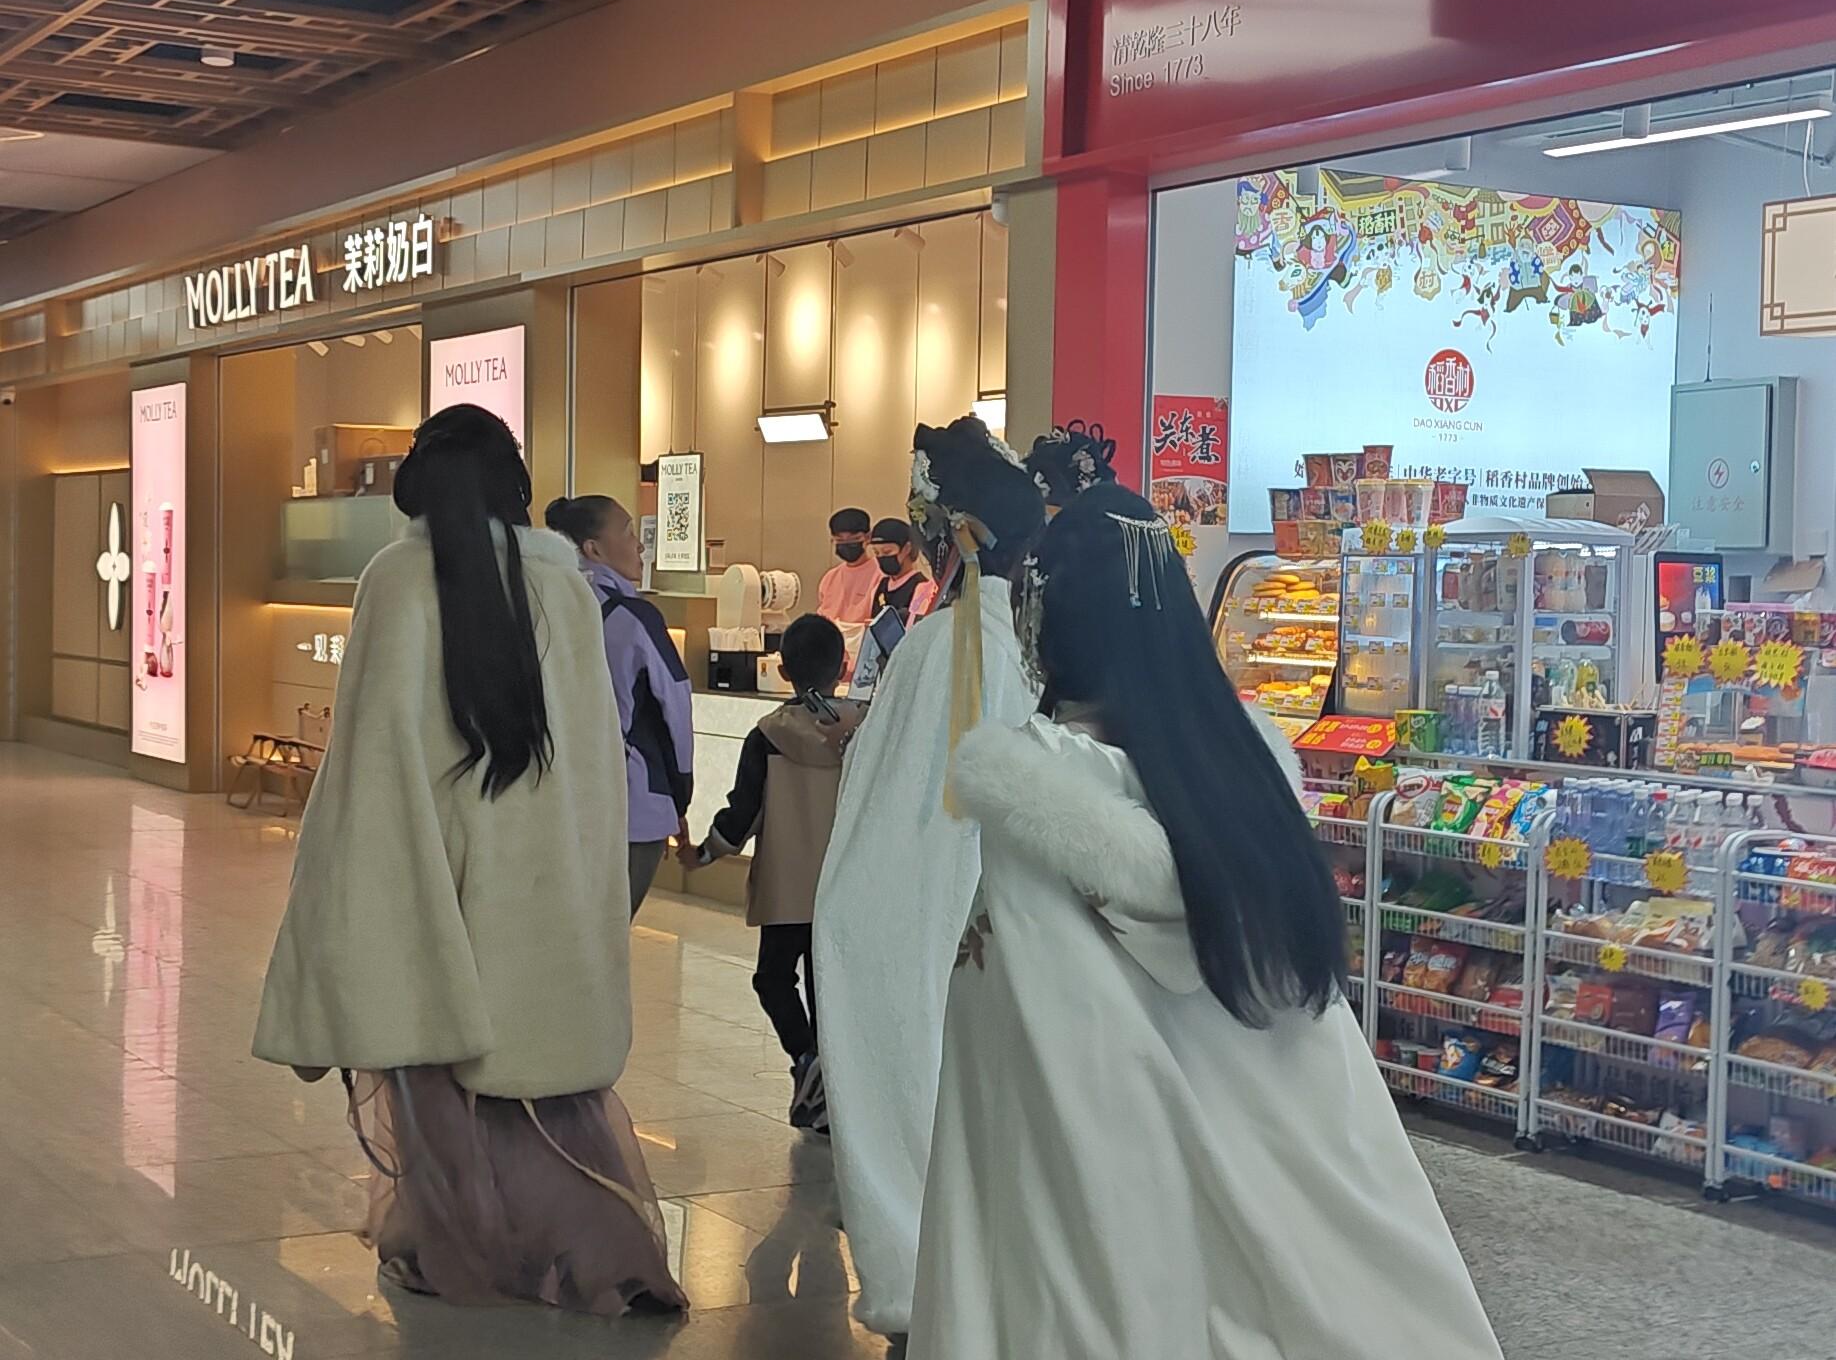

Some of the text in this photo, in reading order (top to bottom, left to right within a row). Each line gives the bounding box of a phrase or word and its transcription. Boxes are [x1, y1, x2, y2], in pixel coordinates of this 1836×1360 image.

[1112, 5, 1242, 67] 清乾隆三十八年
[1110, 53, 1204, 97] Since 1773
[342, 213, 434, 294] 茉莉奶白
[184, 243, 316, 330] MOLLY TEA
[445, 355, 508, 388] MOLLY TEA
[1427, 356, 1471, 397] 稻香村
[1153, 409, 1221, 465] 关东煮
[1413, 417, 1483, 432] DAO XIANG CUN
[685, 462, 698, 475] TEA
[1403, 464, 1477, 487] 中华老字号
